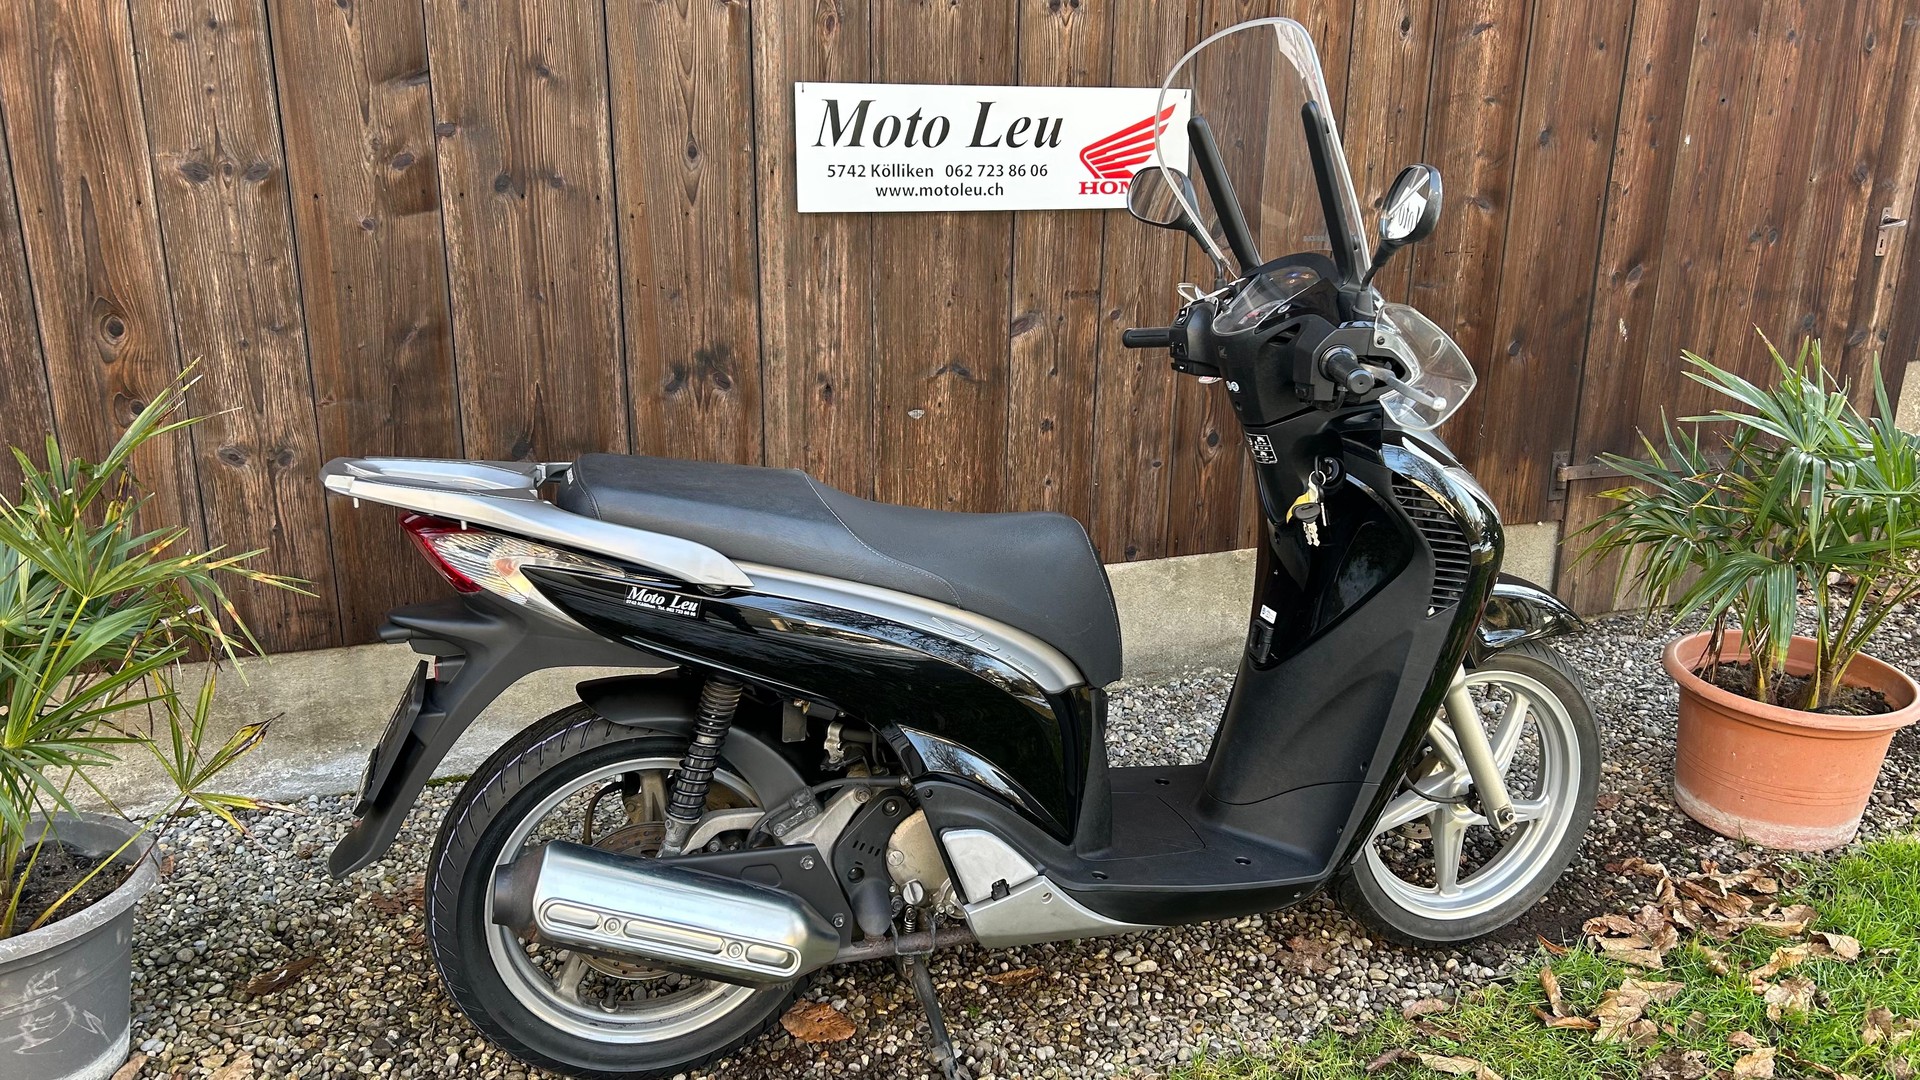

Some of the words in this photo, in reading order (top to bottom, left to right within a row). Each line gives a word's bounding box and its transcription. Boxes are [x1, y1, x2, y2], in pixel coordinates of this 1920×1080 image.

[811, 99, 951, 149] Moto
[965, 101, 1064, 149] Leu
[827, 164, 866, 178] 5742
[871, 163, 934, 178] Kölliken
[945, 164, 973, 178] 062
[977, 164, 1004, 178] 723
[1008, 164, 1026, 178] 86
[1030, 164, 1048, 178] 06
[875, 182, 1004, 197] www.motoleu.ch
[1078, 181, 1130, 195] HON
[626, 586, 666, 605] Moto
[669, 594, 699, 612] Leu
